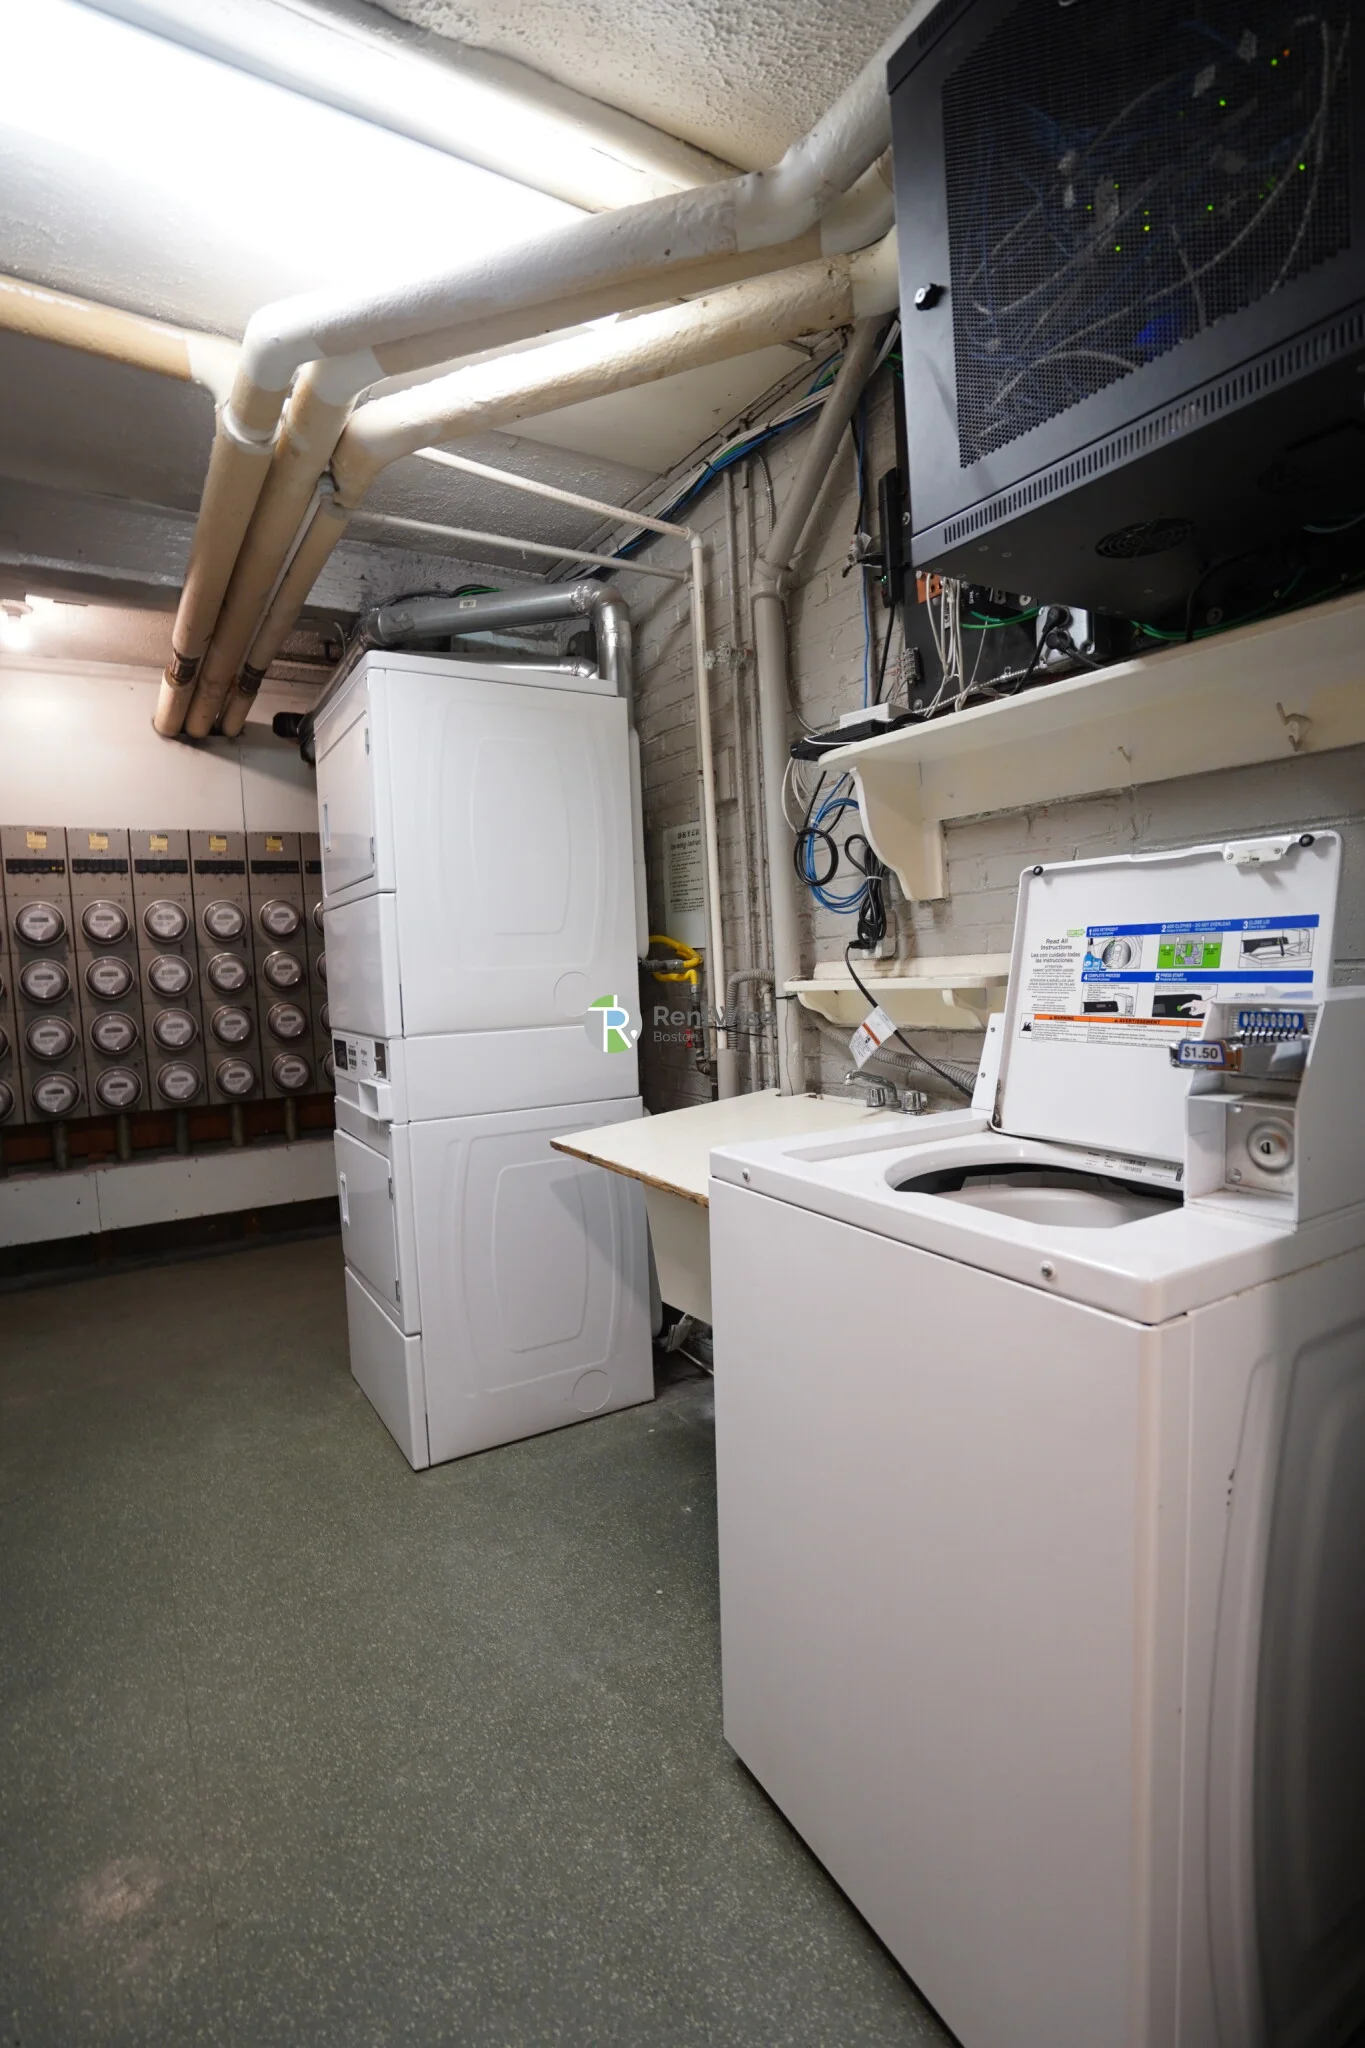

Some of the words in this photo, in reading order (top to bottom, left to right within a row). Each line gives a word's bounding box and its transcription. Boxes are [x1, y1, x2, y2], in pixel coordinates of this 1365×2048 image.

[677, 828, 700, 839] DRYER
[1161, 924, 1166, 933] 2
[1242, 920, 1249, 930] 3
[1088, 928, 1092, 936] 1
[1083, 973, 1088, 981] 4
[1155, 972, 1160, 981] 5
[1184, 1046, 1219, 1059] $1.50
